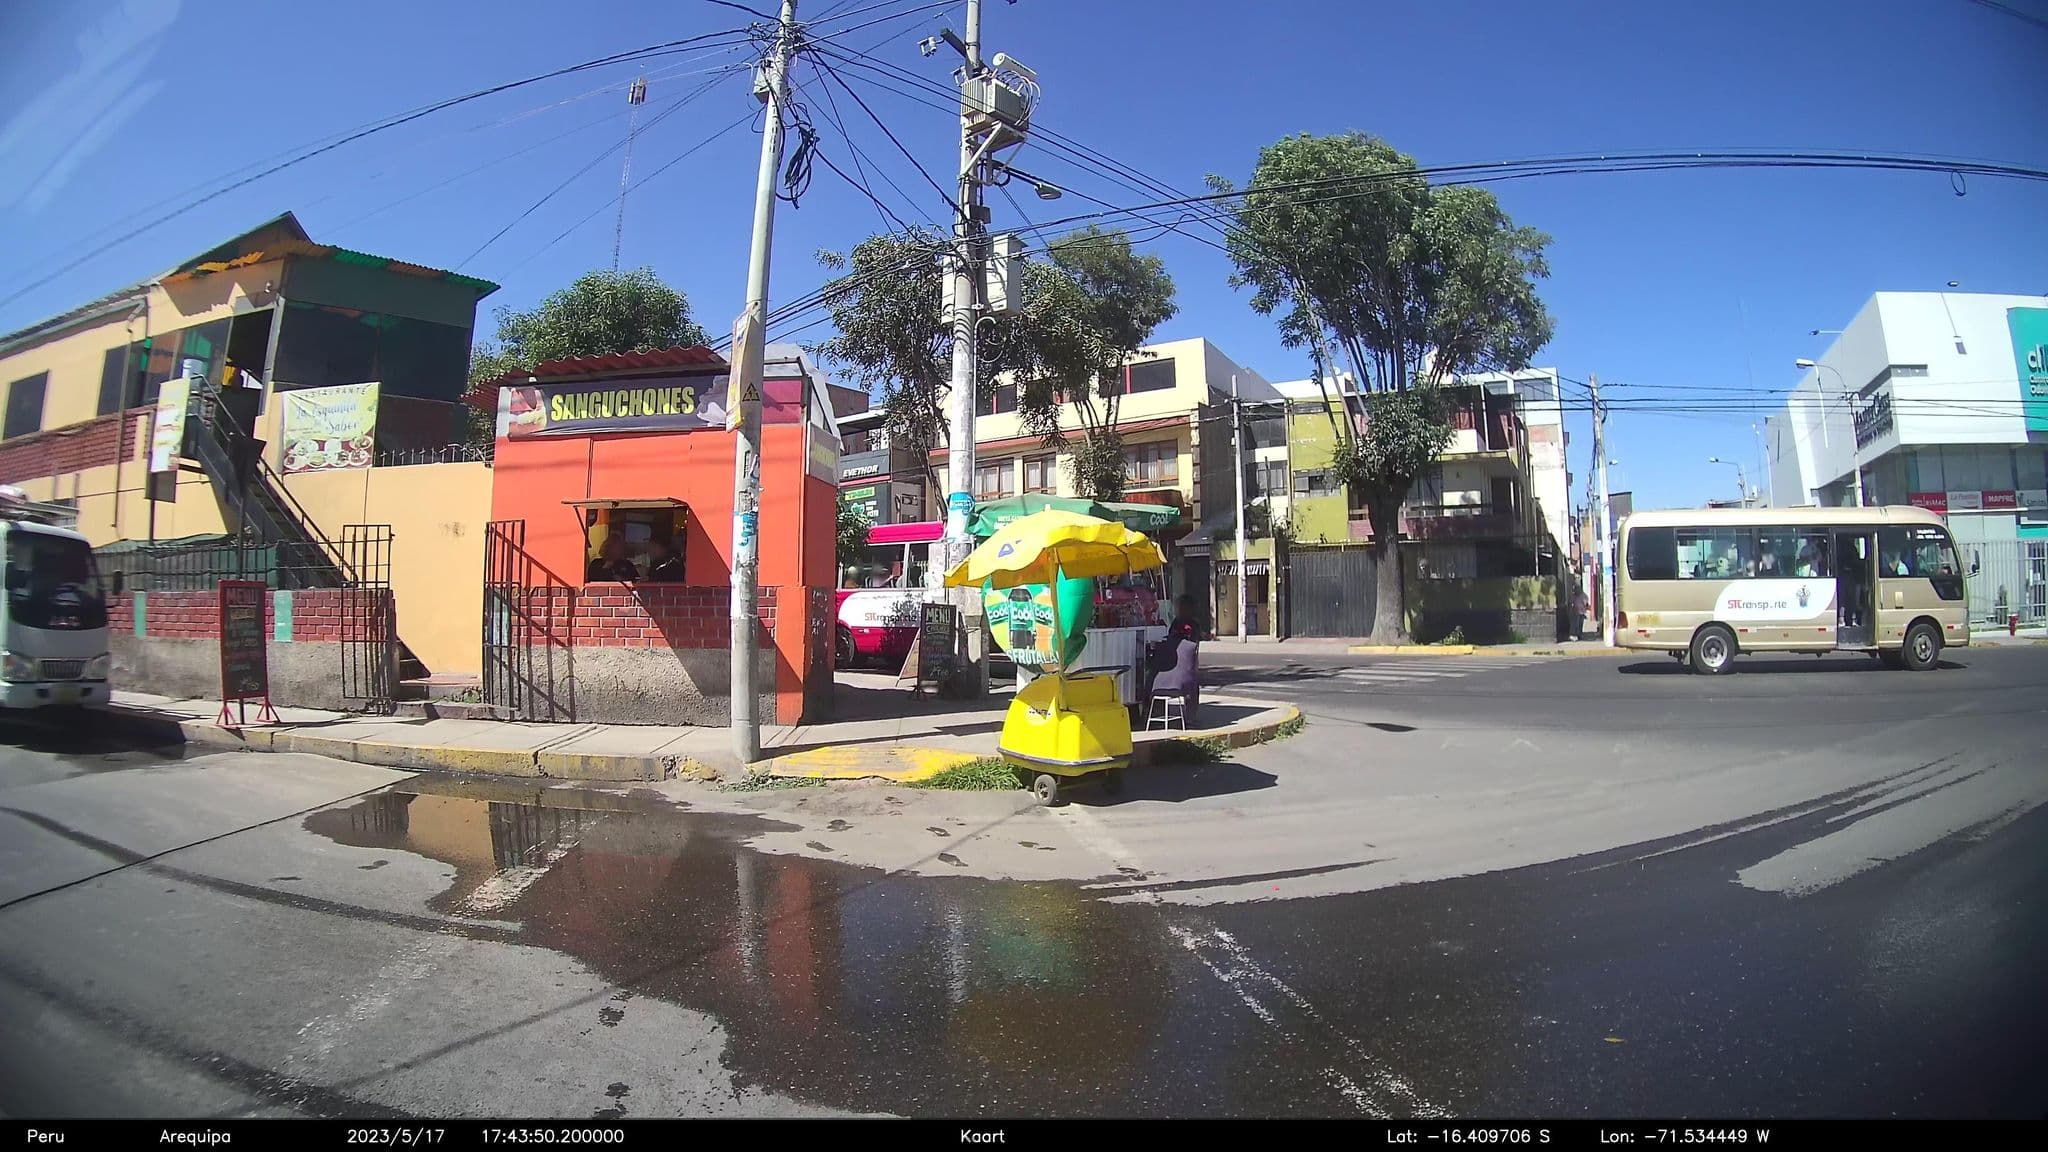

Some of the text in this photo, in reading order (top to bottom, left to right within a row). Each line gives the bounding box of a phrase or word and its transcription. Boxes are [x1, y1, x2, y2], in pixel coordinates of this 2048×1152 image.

[299, 384, 366, 400] ESTAURANTE
[551, 386, 696, 422] SANGUCHONES
[843, 464, 879, 479] EVETHOR
[1988, 494, 2014, 503] MAPFRE
